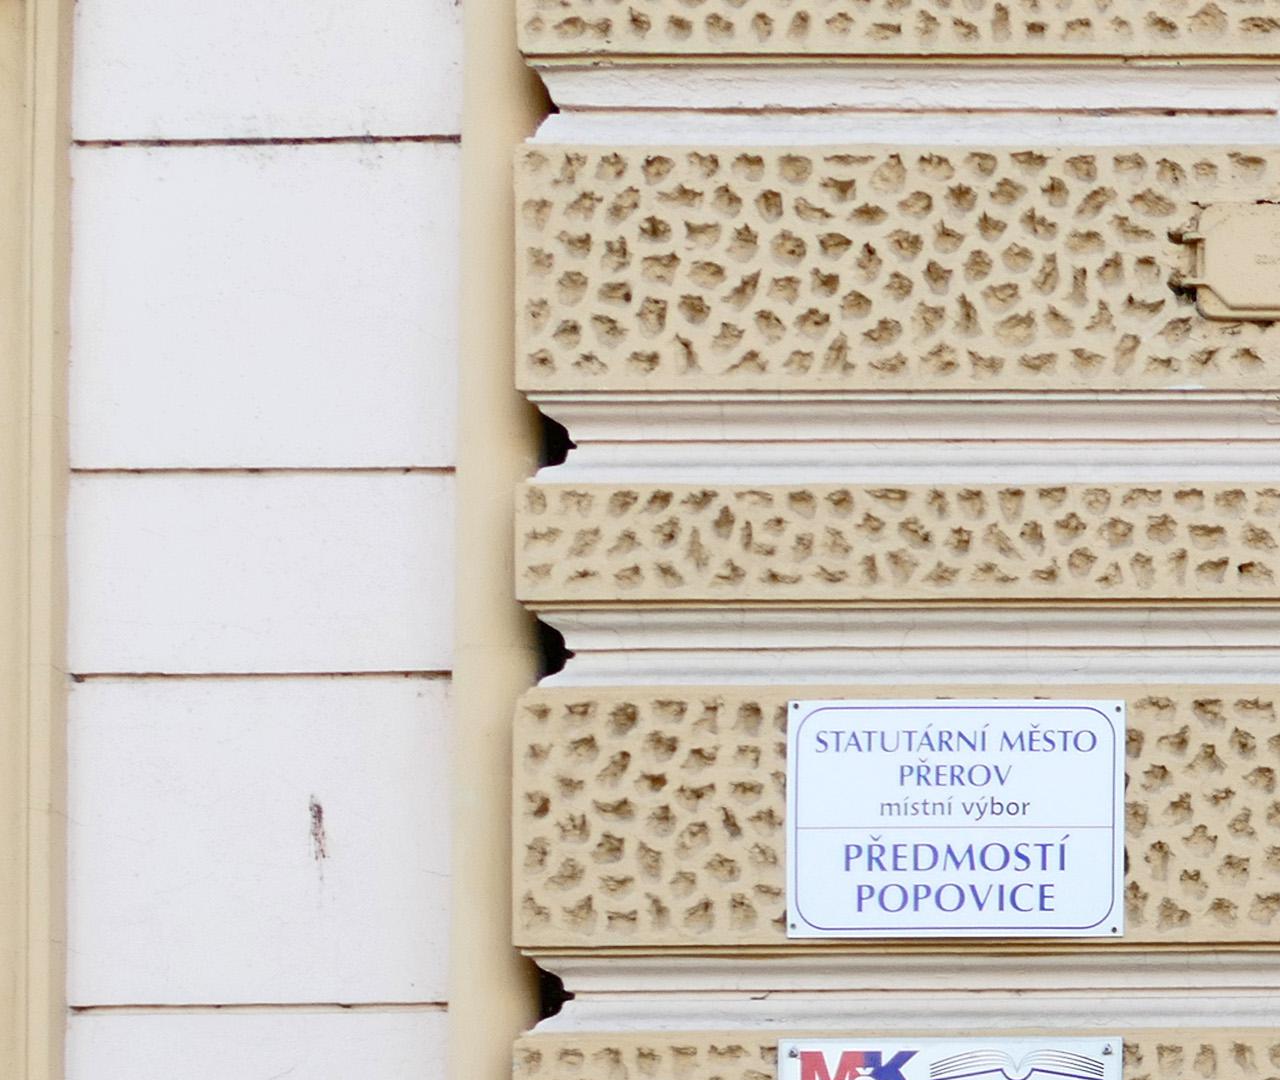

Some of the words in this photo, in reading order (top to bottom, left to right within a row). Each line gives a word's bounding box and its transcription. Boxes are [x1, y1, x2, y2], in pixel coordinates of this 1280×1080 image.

[815, 723, 989, 753] STATUTÁRNÍ
[999, 723, 1098, 753] MĚSTO
[899, 757, 1013, 787] PŘEROV
[880, 796, 954, 816] místní
[961, 796, 1031, 821] výbor
[844, 833, 1071, 872] PŘEDMOSTÍ
[856, 883, 1056, 913] POPOVICE
